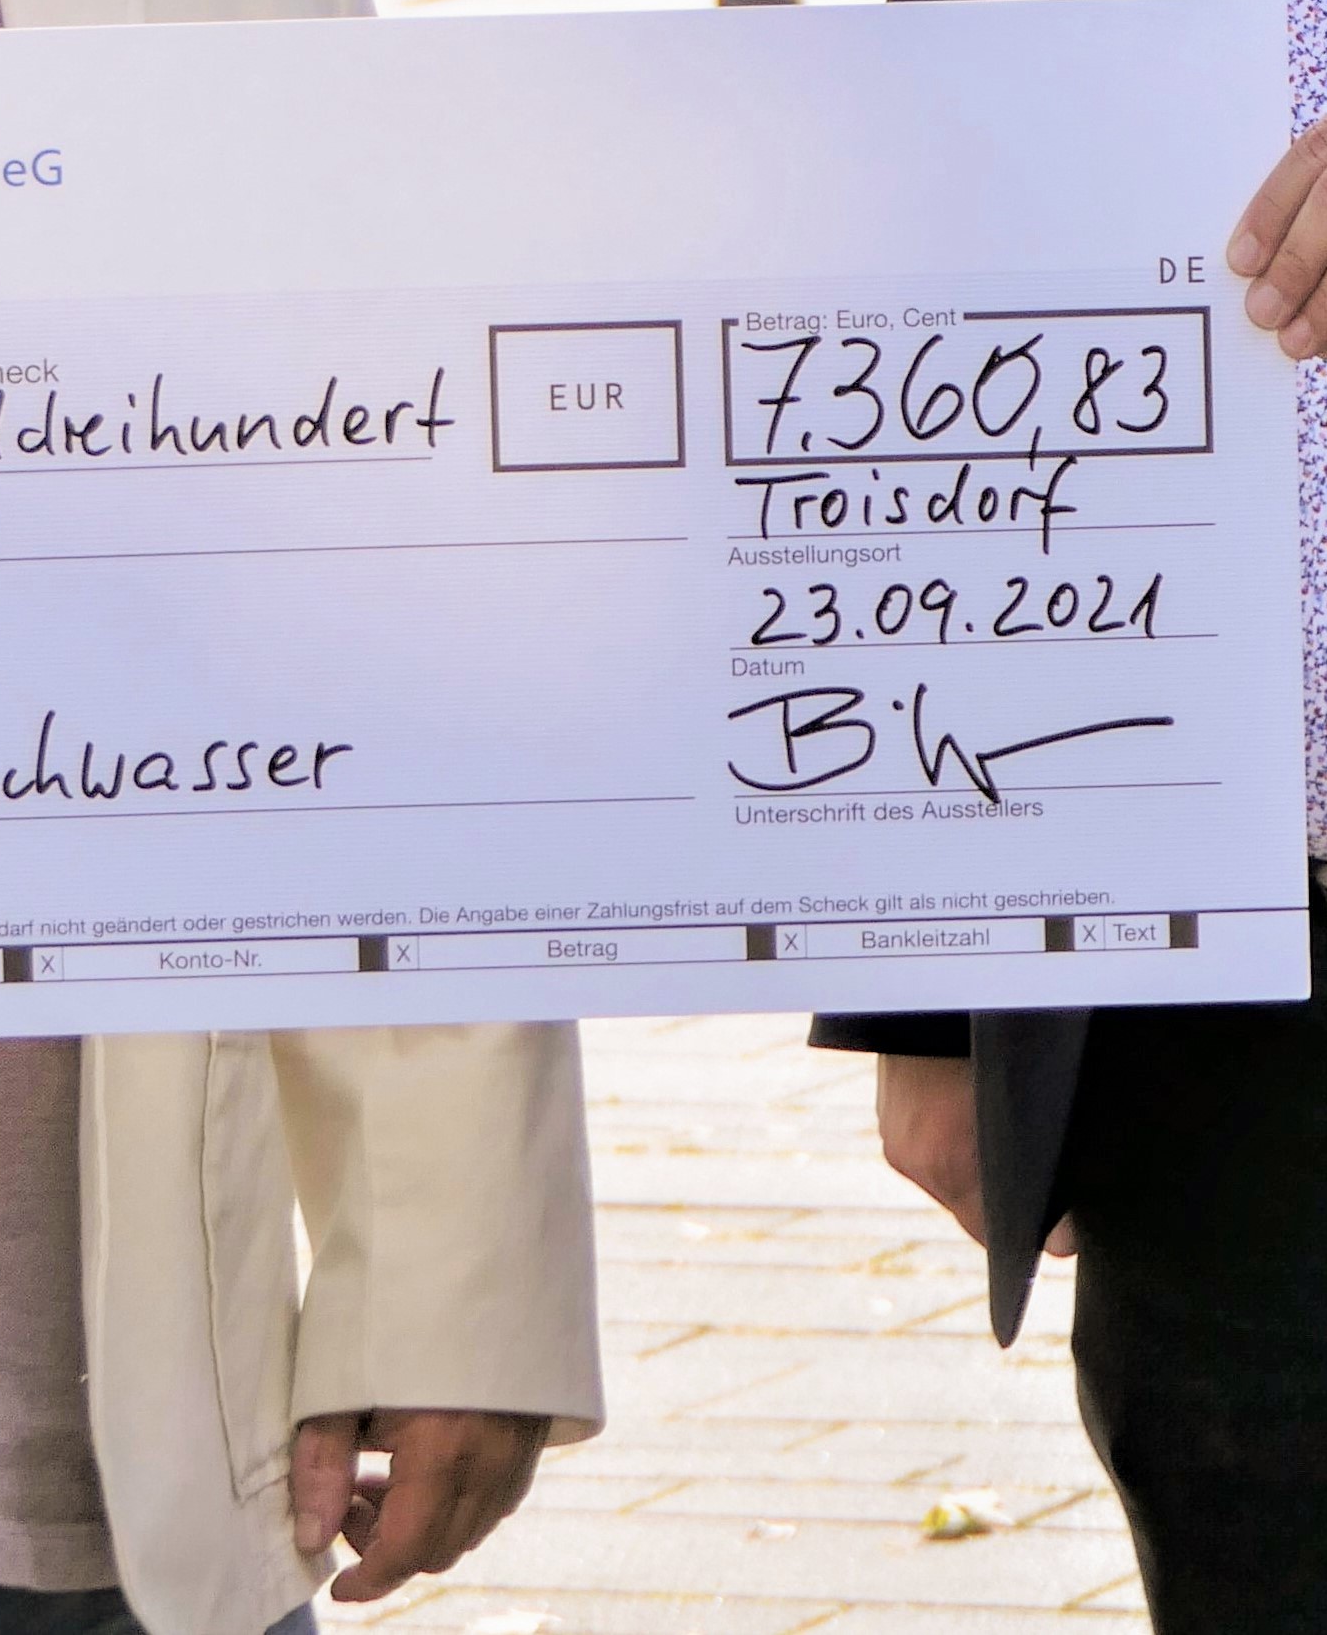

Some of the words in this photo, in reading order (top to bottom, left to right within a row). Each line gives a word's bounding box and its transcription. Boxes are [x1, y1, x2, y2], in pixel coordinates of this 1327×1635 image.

[2, 149, 64, 186] eG
[745, 312, 829, 333] Betrag:
[836, 310, 894, 331] Euro,
[903, 308, 958, 327] Cent
[549, 382, 626, 411] EUR
[740, 333, 1170, 472] 7.360,83
[734, 453, 1079, 556] Troisdorf
[727, 543, 903, 569] Ausstellungsort
[750, 572, 1164, 646] 23.09.2021
[731, 657, 806, 678] Datum
[735, 801, 868, 826] Unterschrift
[874, 799, 916, 822] des
[921, 797, 1045, 821] Ausstellers
[40, 918, 86, 936] nicht
[92, 916, 177, 937] geändert
[183, 915, 226, 932] oder
[232, 912, 331, 931] gestrichen
[337, 909, 413, 928] werden.
[419, 907, 451, 924] Die
[456, 905, 529, 926] Angabe
[534, 903, 582, 921] einer
[587, 900, 709, 922] Zahlungsfrist
[714, 898, 745, 916] auf
[751, 897, 793, 915] dem
[798, 895, 870, 914] Scheck
[875, 894, 903, 915] gilt
[909, 894, 937, 912] als
[942, 892, 989, 910] nicht
[994, 889, 1115, 911] geschrieben.
[783, 933, 799, 952] X
[861, 927, 991, 950] Bankleitzahl
[1081, 923, 1098, 943] X
[1112, 922, 1158, 942] Text
[159, 949, 263, 970] Konto-Nr.
[395, 944, 411, 964] X
[547, 938, 619, 961] Betrag
[40, 954, 57, 974] X
